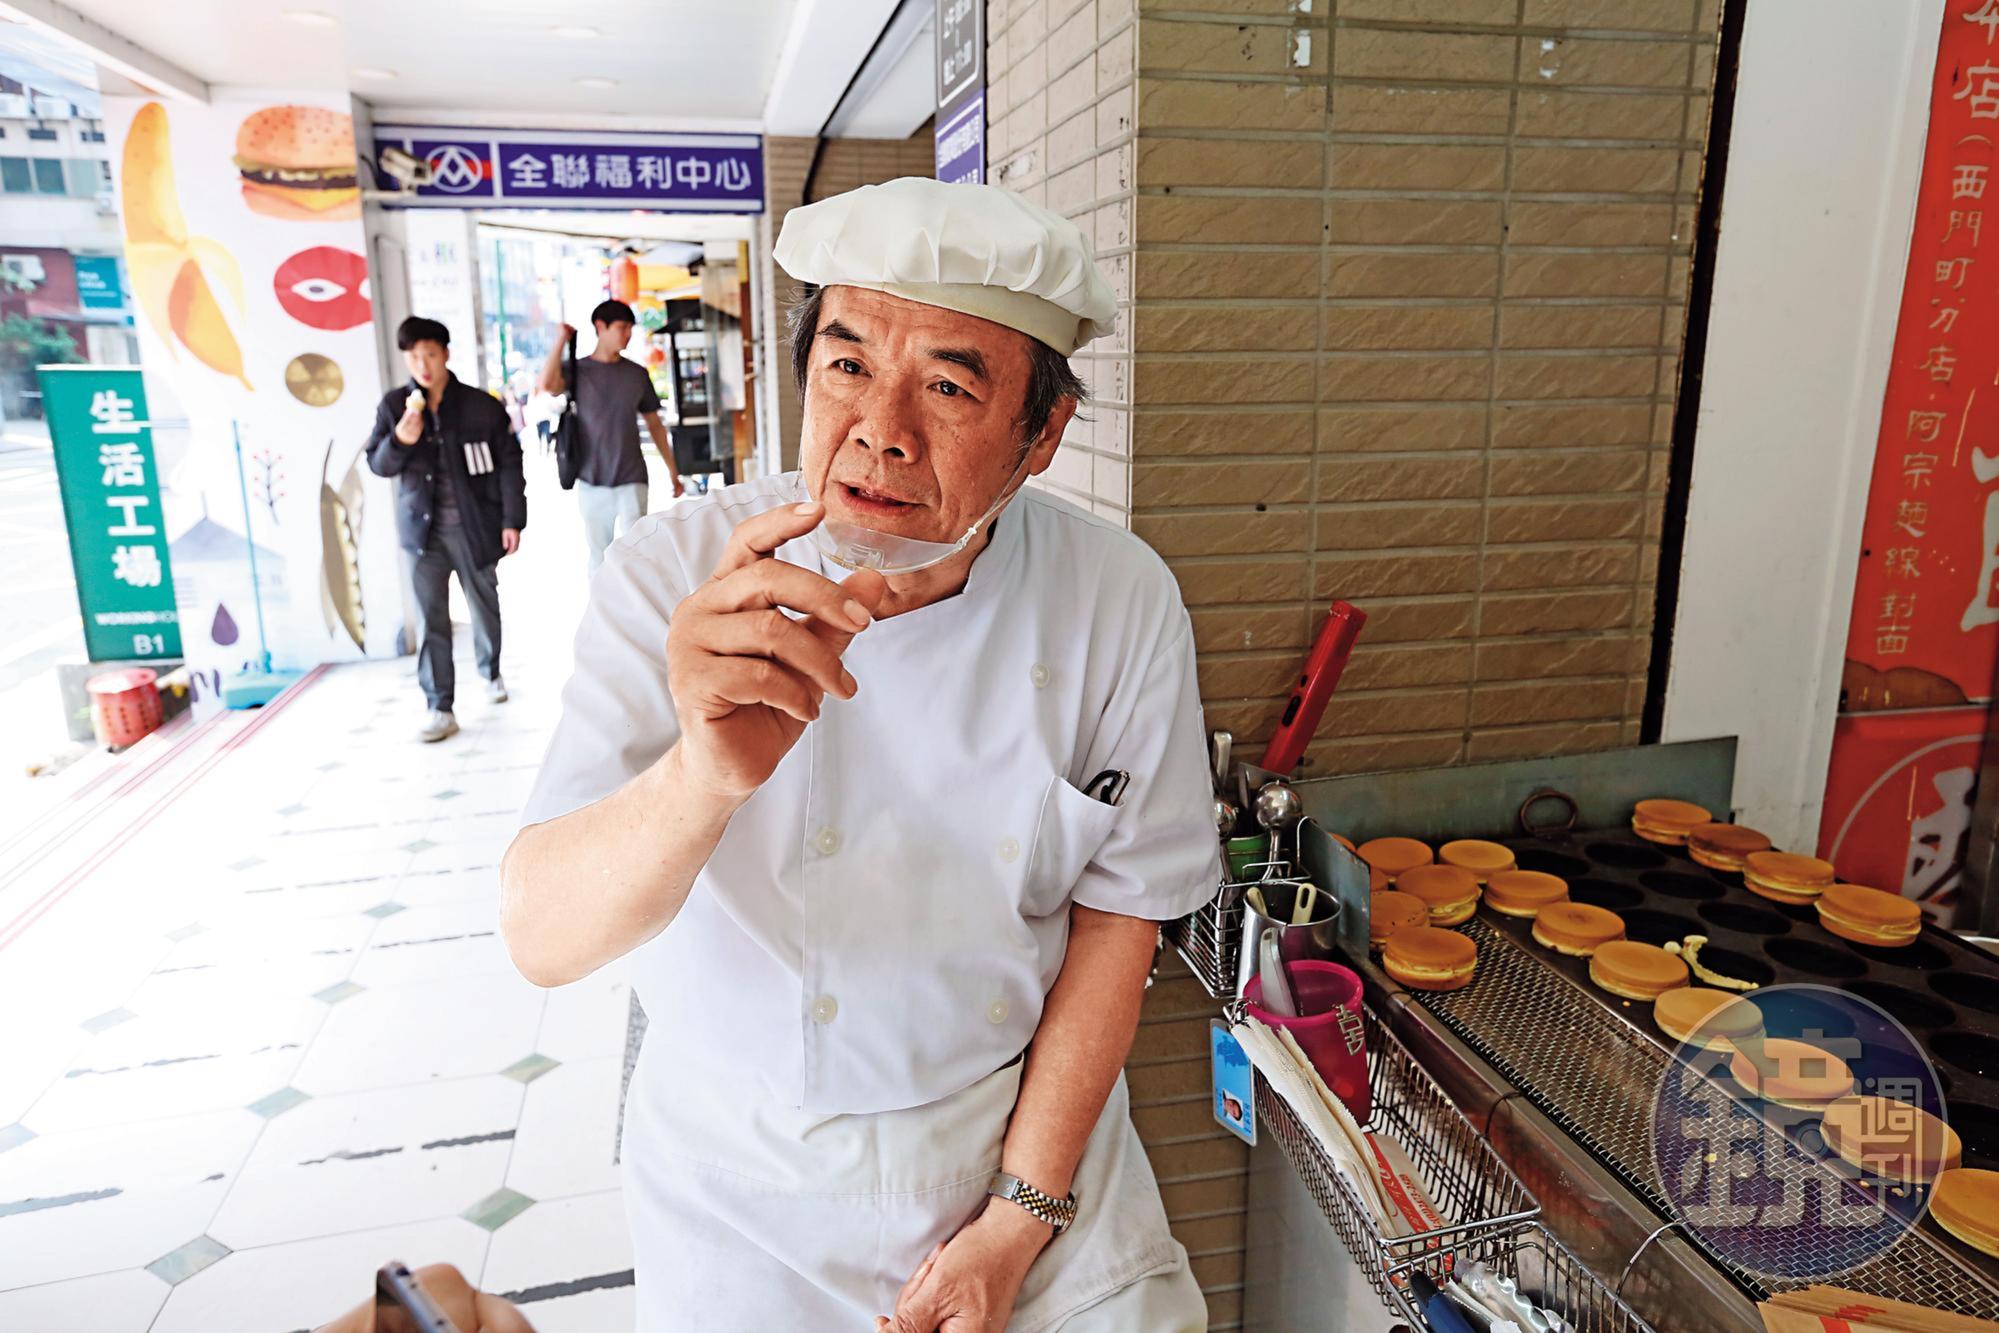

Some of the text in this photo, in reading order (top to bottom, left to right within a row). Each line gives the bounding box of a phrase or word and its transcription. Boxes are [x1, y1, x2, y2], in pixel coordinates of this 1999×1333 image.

[507, 152, 752, 192] 全聯福利中心
[89, 389, 163, 588] 生活工場
[132, 633, 165, 656] B1
